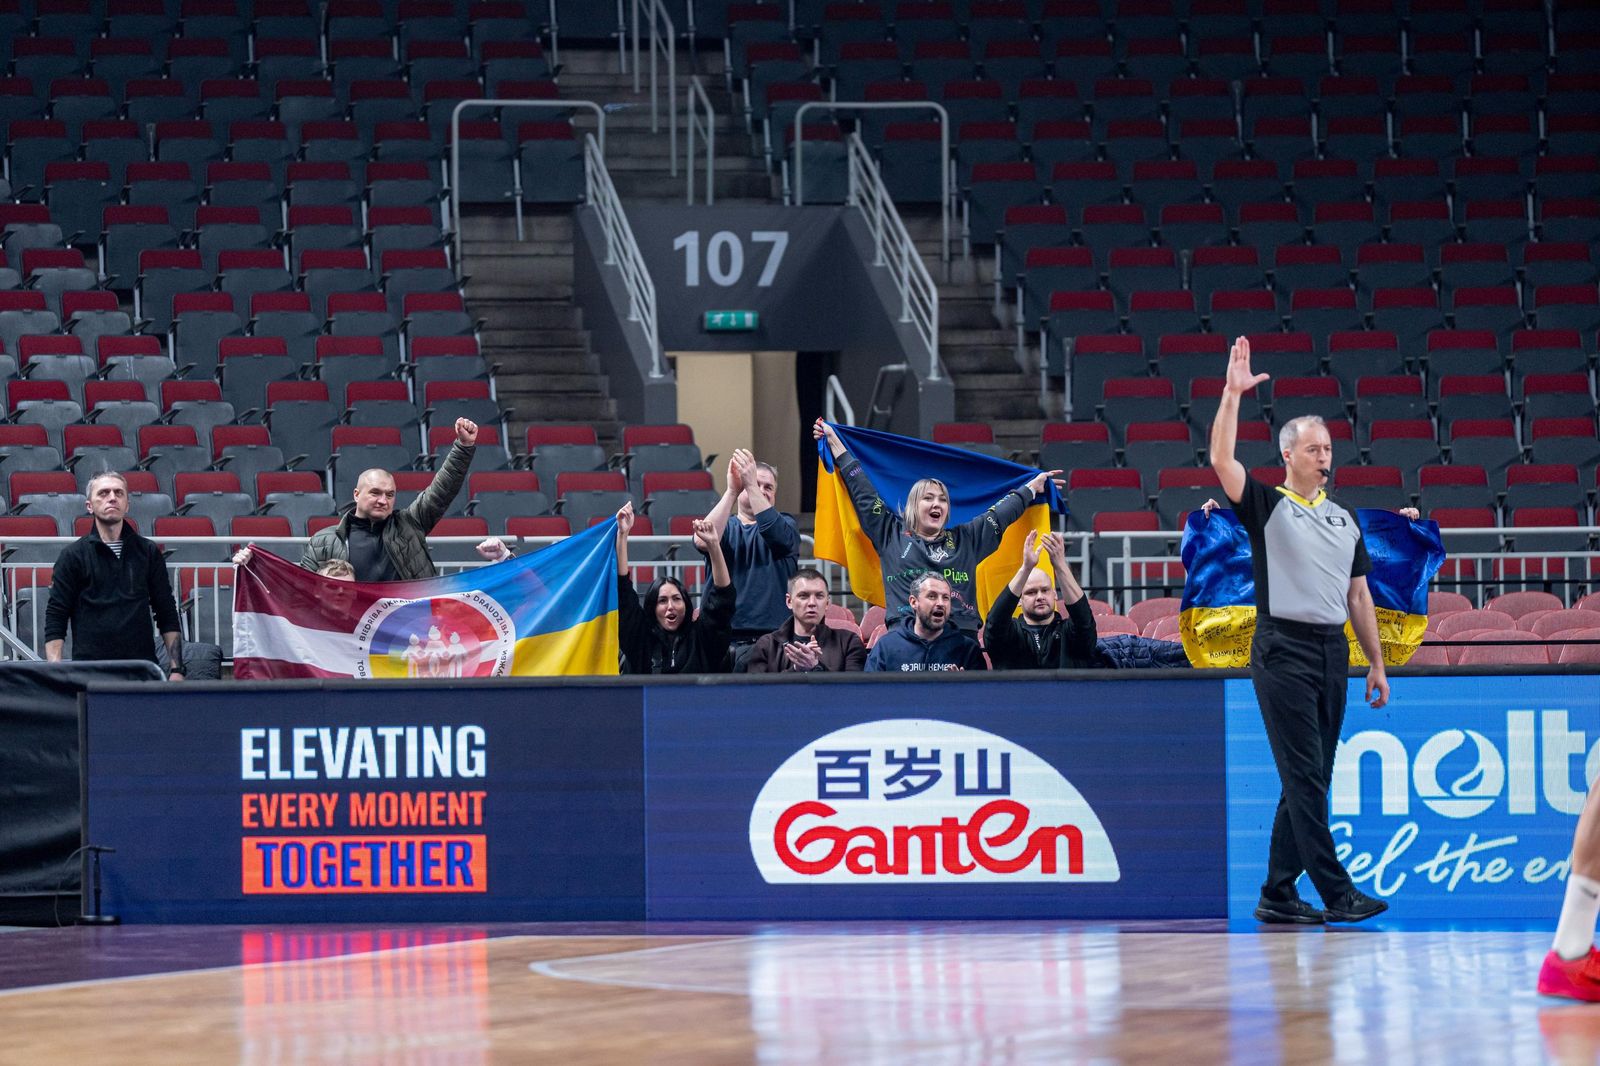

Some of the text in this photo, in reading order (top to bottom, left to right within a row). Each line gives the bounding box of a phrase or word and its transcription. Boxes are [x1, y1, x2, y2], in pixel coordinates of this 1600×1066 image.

[673, 231, 789, 287] 107
[943, 567, 969, 584] Рідна
[241, 725, 486, 780] ELEVATING
[814, 746, 1012, 800] 百岁山
[242, 791, 487, 828] EVERY MOMENT
[255, 841, 474, 888] TOGETHER
[1413, 833, 1518, 892] the
